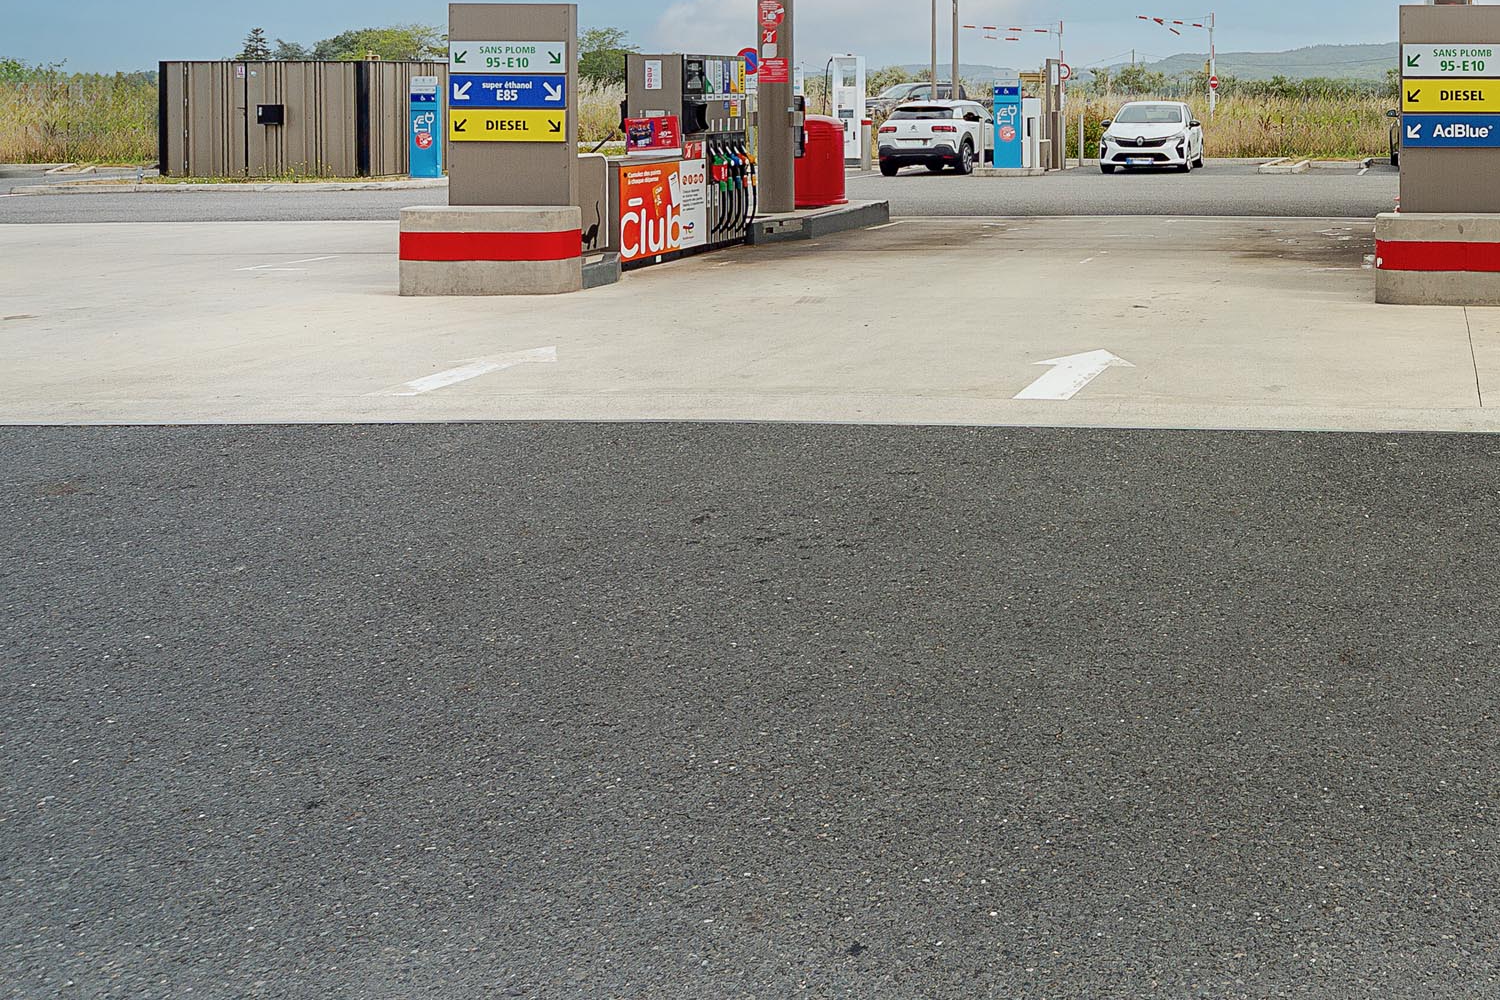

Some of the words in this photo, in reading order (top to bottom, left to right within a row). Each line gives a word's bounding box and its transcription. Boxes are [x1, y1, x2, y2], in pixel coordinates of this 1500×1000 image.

[479, 46, 502, 54] SANS
[505, 46, 536, 54] PLOMB
[1433, 48, 1457, 57] SANS
[1460, 48, 1492, 57] PLOMB
[486, 57, 529, 68] 95-E10
[1440, 60, 1485, 72] 95-E10
[482, 82, 502, 90] super
[504, 81, 532, 89] éthanol
[496, 89, 519, 101] E85
[1440, 90, 1485, 101] DIESEL
[485, 120, 529, 131] DIESEL
[620, 204, 680, 259] Club
